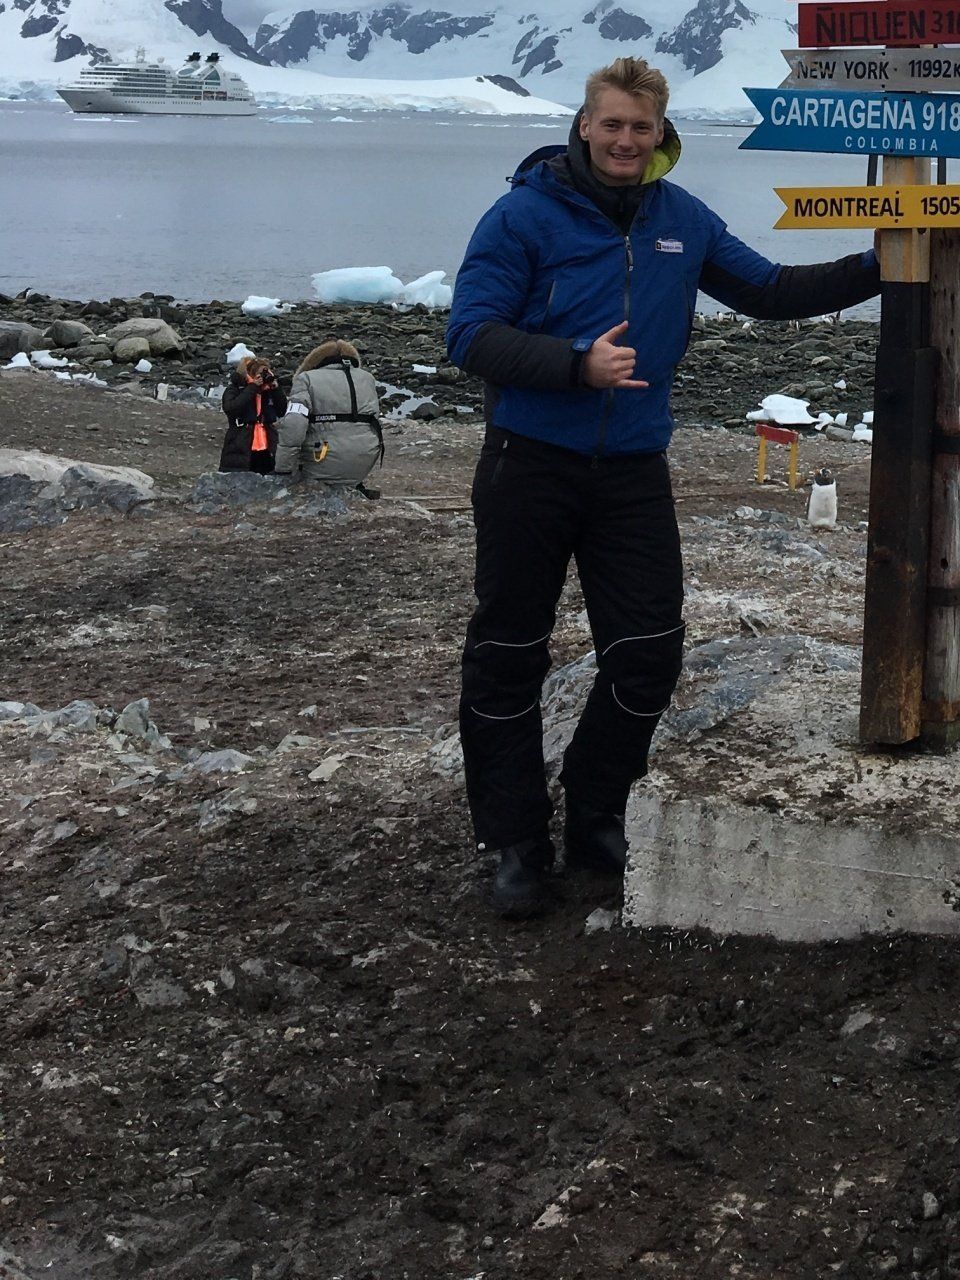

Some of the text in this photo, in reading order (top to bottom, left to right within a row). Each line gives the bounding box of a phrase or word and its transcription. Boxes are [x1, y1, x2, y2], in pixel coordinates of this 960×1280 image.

[816, 6, 926, 44] ÑIQUEN
[796, 61, 836, 80] NEW
[844, 60, 889, 80] YORK
[770, 96, 916, 131] CARTAGENA
[845, 135, 939, 152] COLOMBIA
[794, 196, 904, 218] MONTREAL
